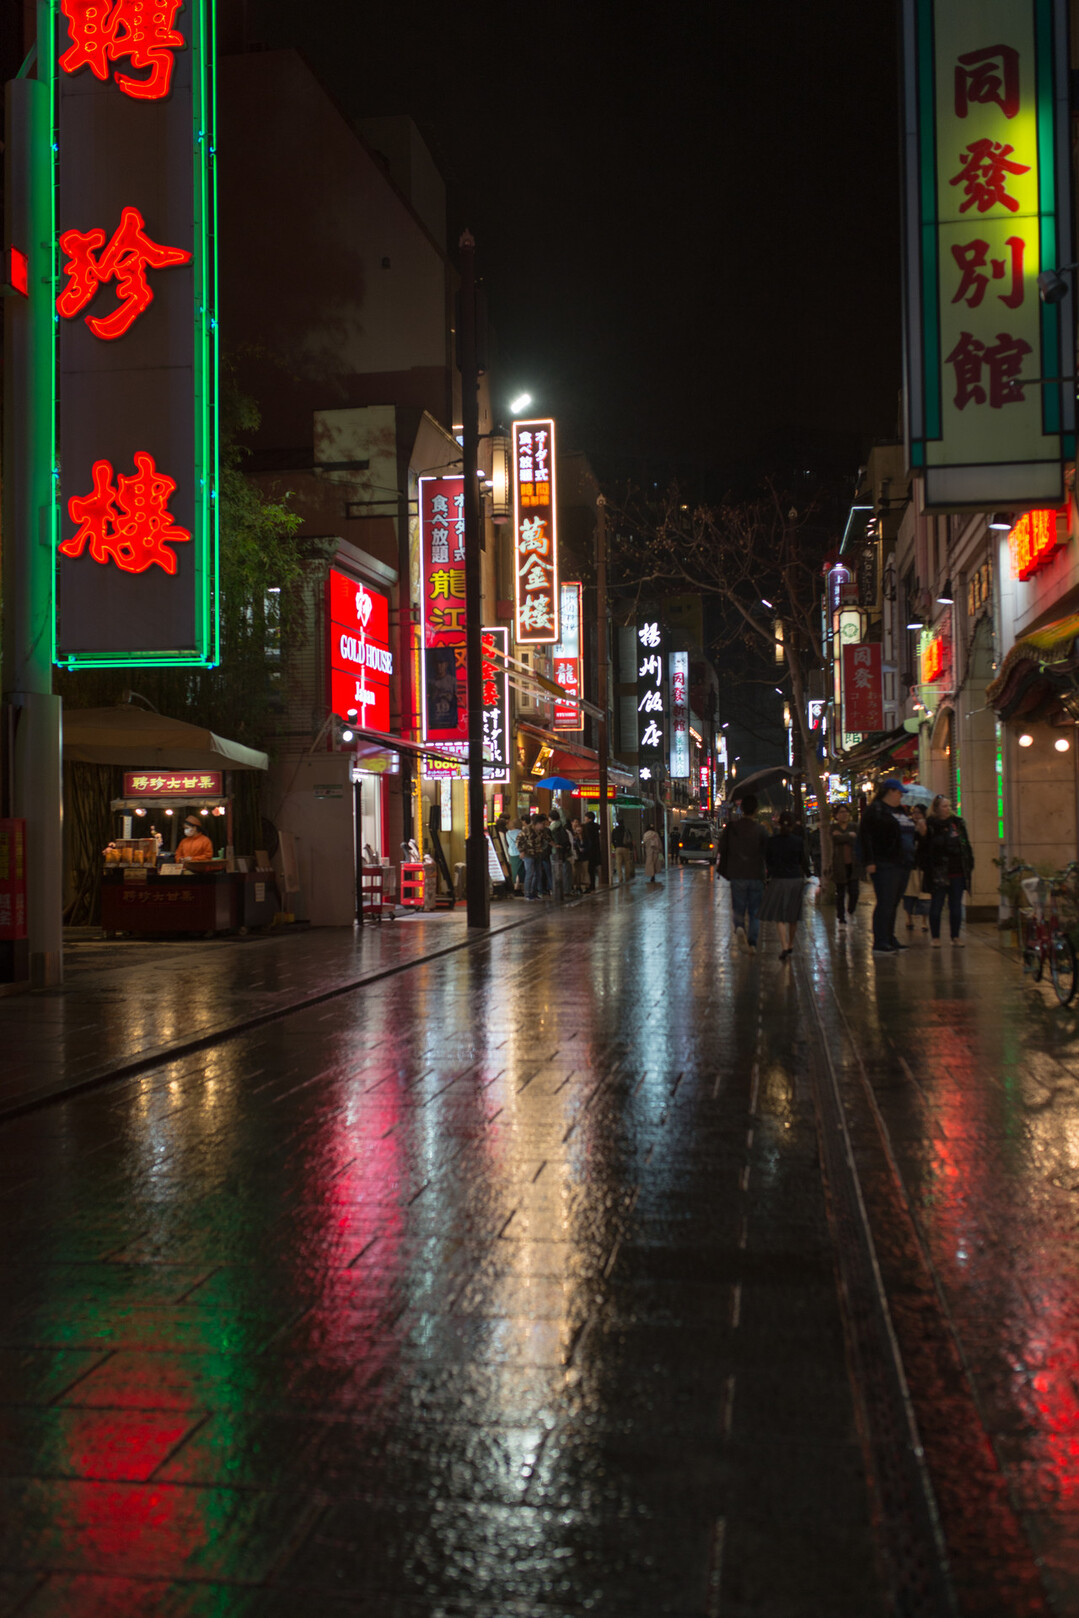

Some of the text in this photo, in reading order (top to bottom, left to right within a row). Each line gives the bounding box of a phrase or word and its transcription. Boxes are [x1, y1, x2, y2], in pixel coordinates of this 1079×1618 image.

[945, 44, 1032, 410] 同發別館
[519, 431, 533, 482] 食べ放題
[535, 430, 549, 482] オーダー式
[431, 494, 449, 563] 食べ放題
[519, 516, 554, 631] 萬金樓
[340, 634, 393, 675] GOLD HOUSE
[853, 646, 874, 689] 同發
[132, 776, 215, 791] 聘珍大甘栗
